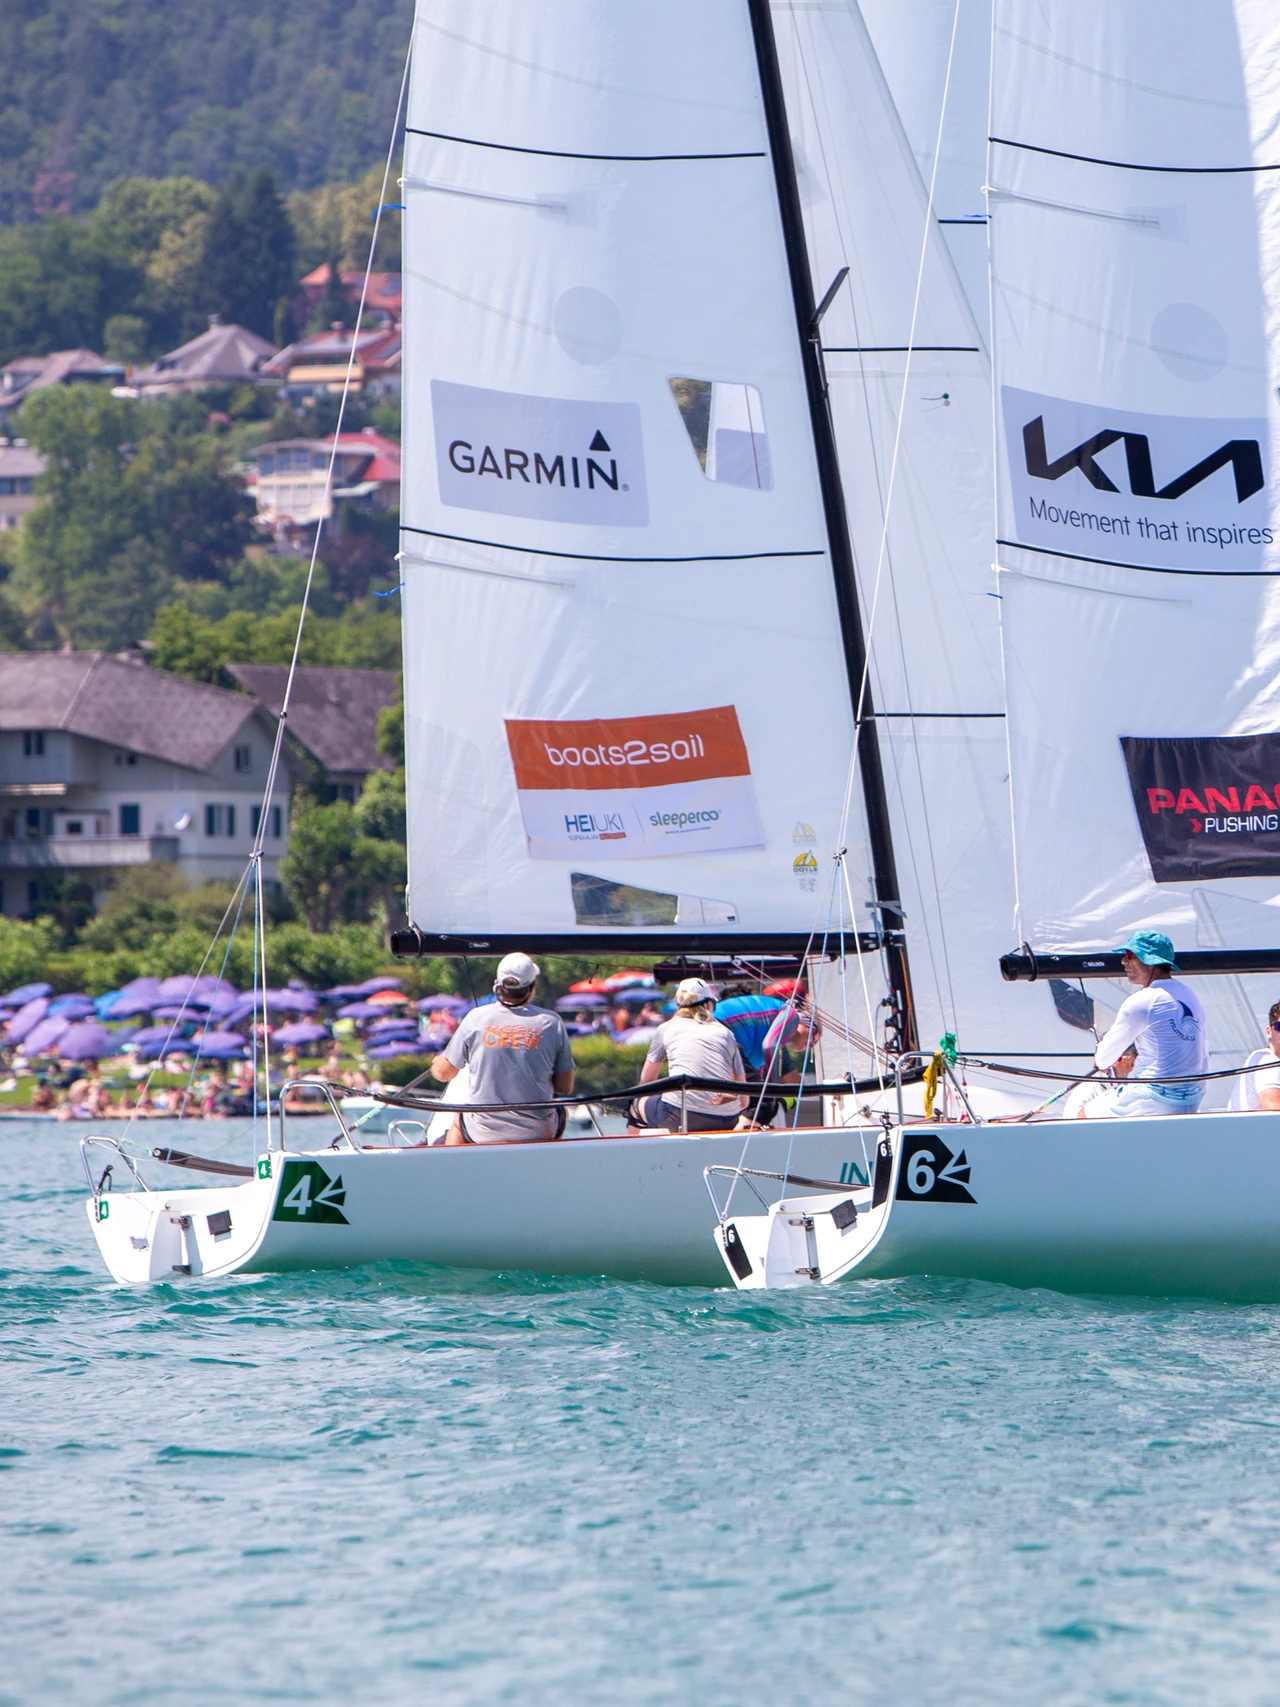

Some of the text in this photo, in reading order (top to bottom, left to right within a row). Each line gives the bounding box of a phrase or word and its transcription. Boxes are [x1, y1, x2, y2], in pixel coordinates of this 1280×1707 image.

[448, 439, 619, 491] GARMIN
[1022, 414, 1265, 504] KIA
[1029, 496, 1274, 549] Movement that inspires
[544, 734, 704, 766] boats2sail
[564, 813, 624, 832] HEIUKI
[1204, 814, 1278, 833] PUSHING
[483, 1029, 543, 1051] CREW
[880, 1143, 888, 1157] 6
[906, 1149, 936, 1195] 6
[283, 1174, 315, 1215] 4
[727, 1228, 735, 1244] 6
